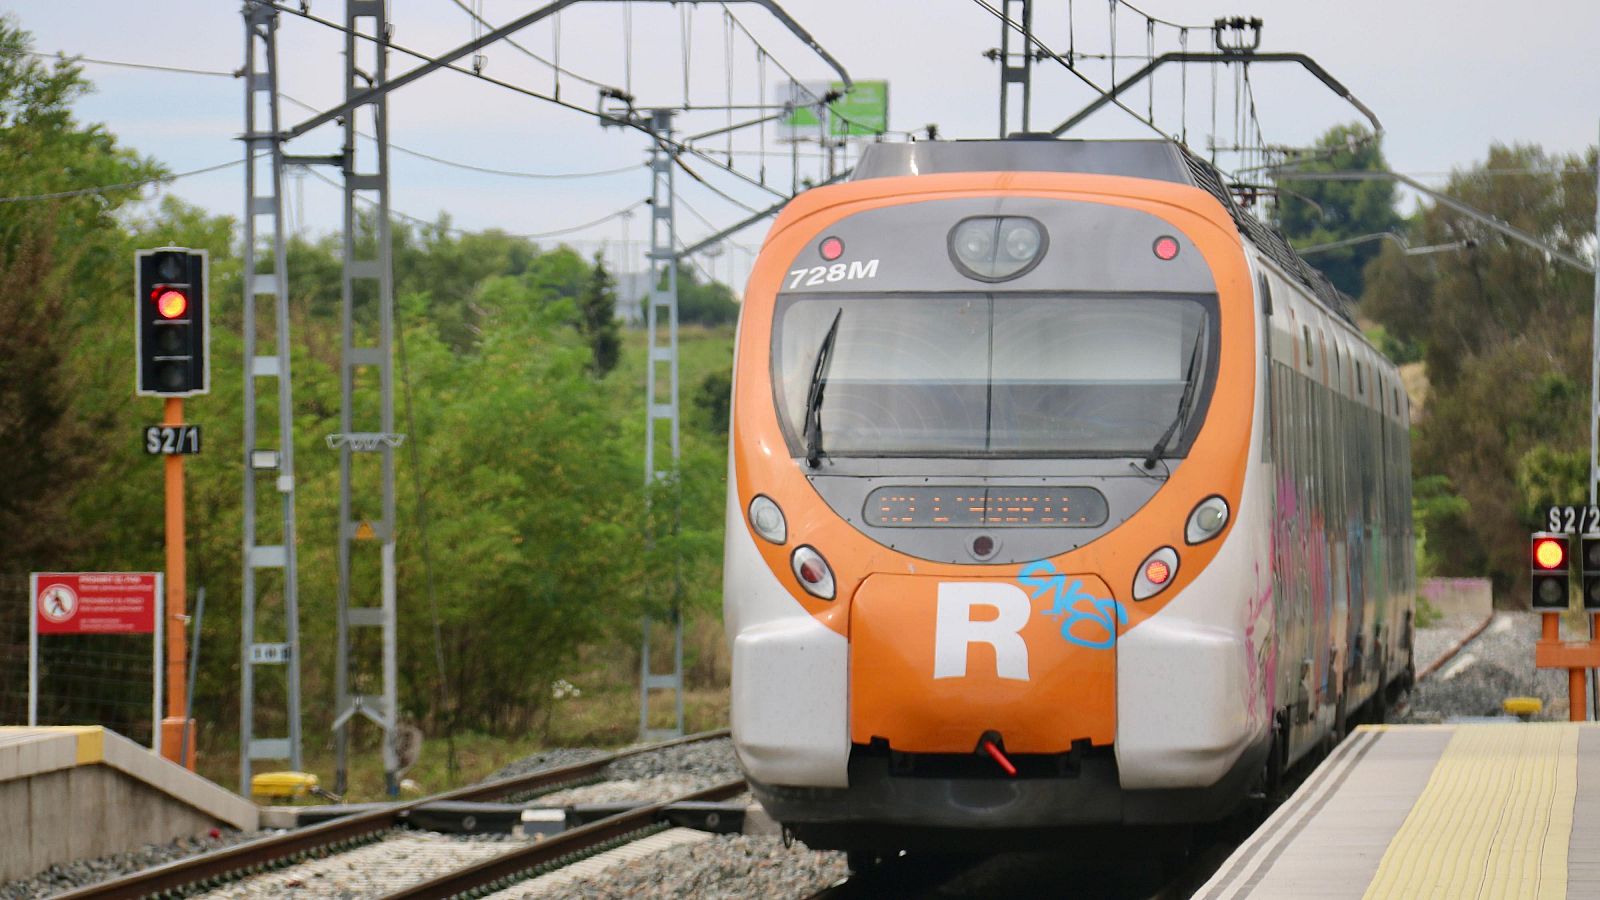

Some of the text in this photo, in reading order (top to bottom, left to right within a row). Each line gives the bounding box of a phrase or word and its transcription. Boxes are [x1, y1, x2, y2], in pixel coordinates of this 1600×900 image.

[789, 259, 880, 290] 728M
[147, 426, 199, 454] S2/1
[1550, 506, 1600, 533] S2/2
[934, 581, 1032, 682] R
